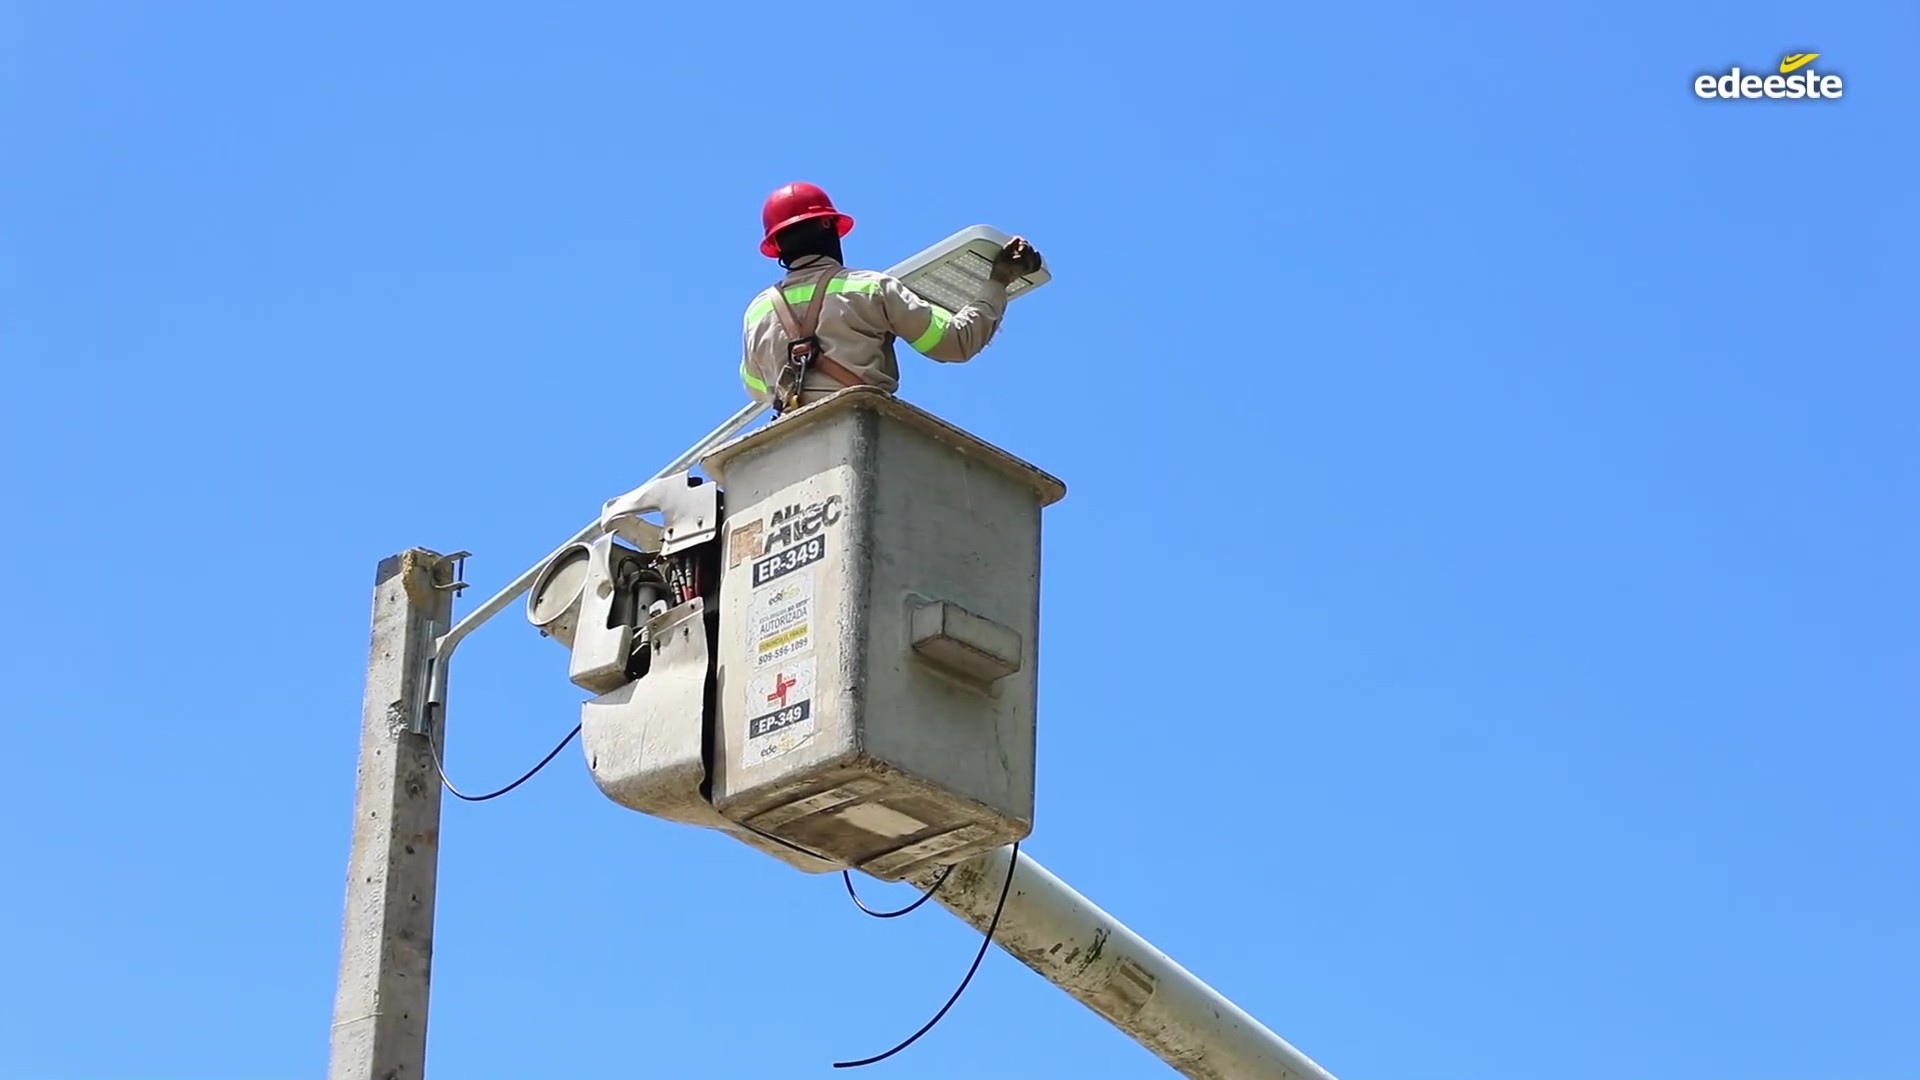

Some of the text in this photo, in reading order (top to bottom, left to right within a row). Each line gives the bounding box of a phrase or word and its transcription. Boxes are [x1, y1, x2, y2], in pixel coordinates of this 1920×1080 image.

[758, 540, 820, 582] EP-349
[760, 606, 808, 635] AUTORIZADA
[758, 706, 802, 733] EP-349
